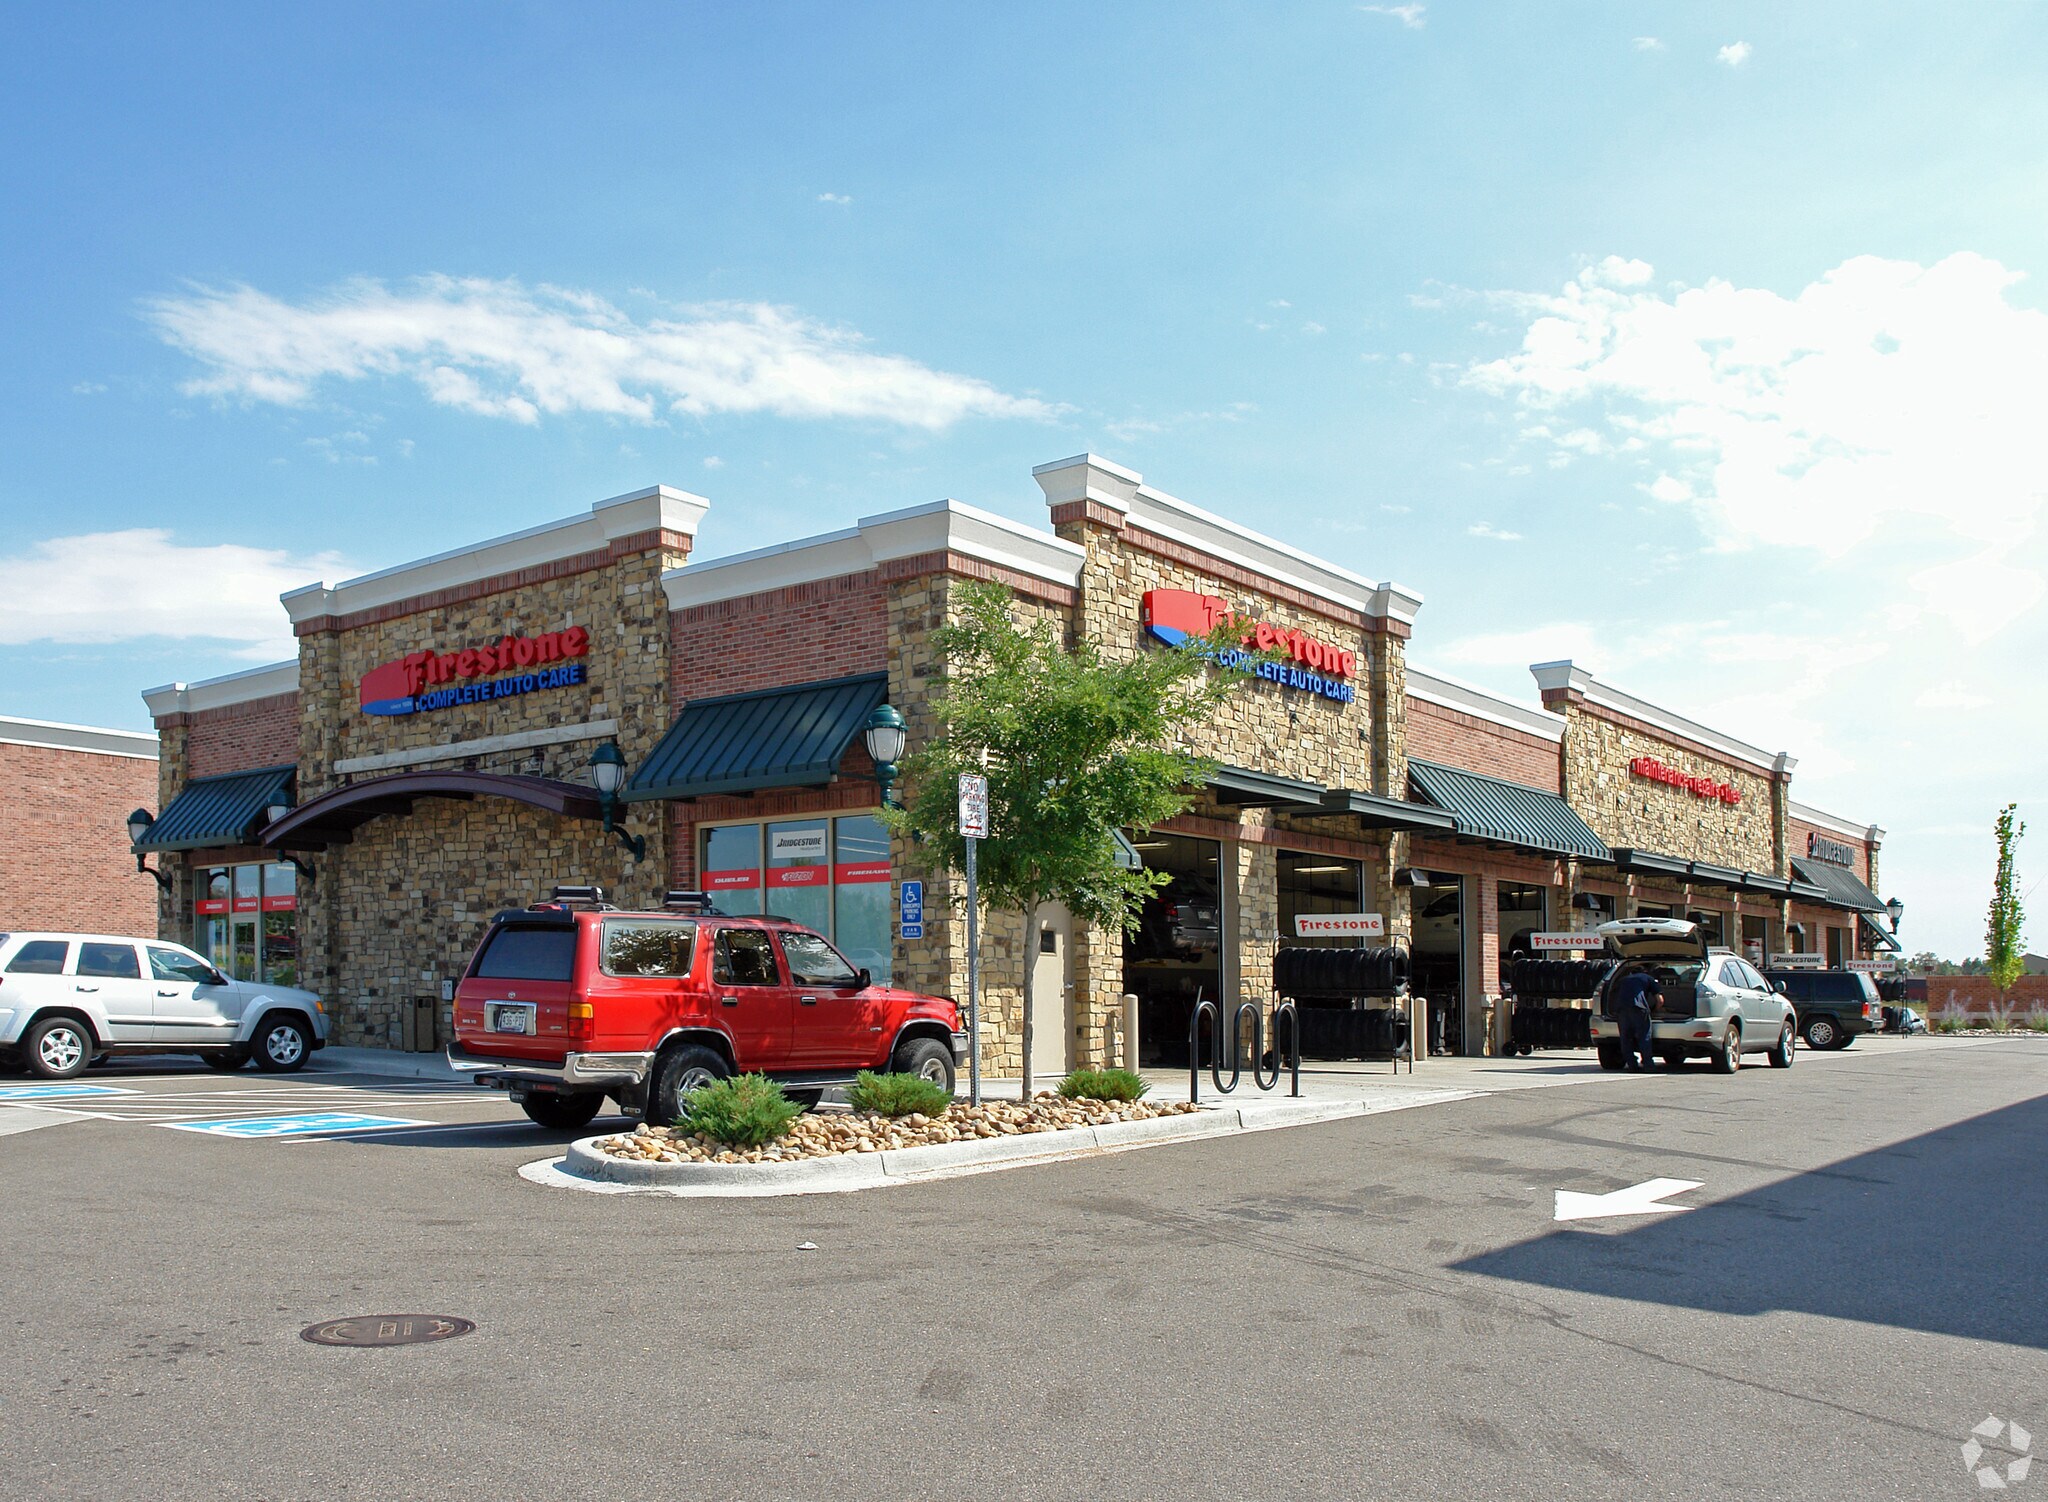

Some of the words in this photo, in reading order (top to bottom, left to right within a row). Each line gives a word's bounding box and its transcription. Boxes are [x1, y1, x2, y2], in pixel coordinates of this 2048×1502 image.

[403, 625, 590, 697] Firestone
[418, 681, 493, 712] COMPLETE
[493, 673, 538, 699] AUTO
[537, 664, 581, 689] CARE
[1289, 667, 1323, 694] AUTO
[1324, 679, 1355, 704] CARE
[967, 781, 979, 792] NO
[1635, 758, 1690, 788] maintenance
[1694, 777, 1720, 797] repairs
[1725, 783, 1741, 804] tires
[776, 837, 822, 848] BRIDGESTONE
[784, 870, 814, 882] FUZION
[847, 869, 891, 877] FIREHAWK
[714, 876, 750, 884] DUELER
[1298, 919, 1380, 933] Firestone
[1533, 936, 1600, 948] Firestone
[1772, 955, 1823, 964] BRIDGESTONE
[1847, 962, 1894, 970] Firestone
